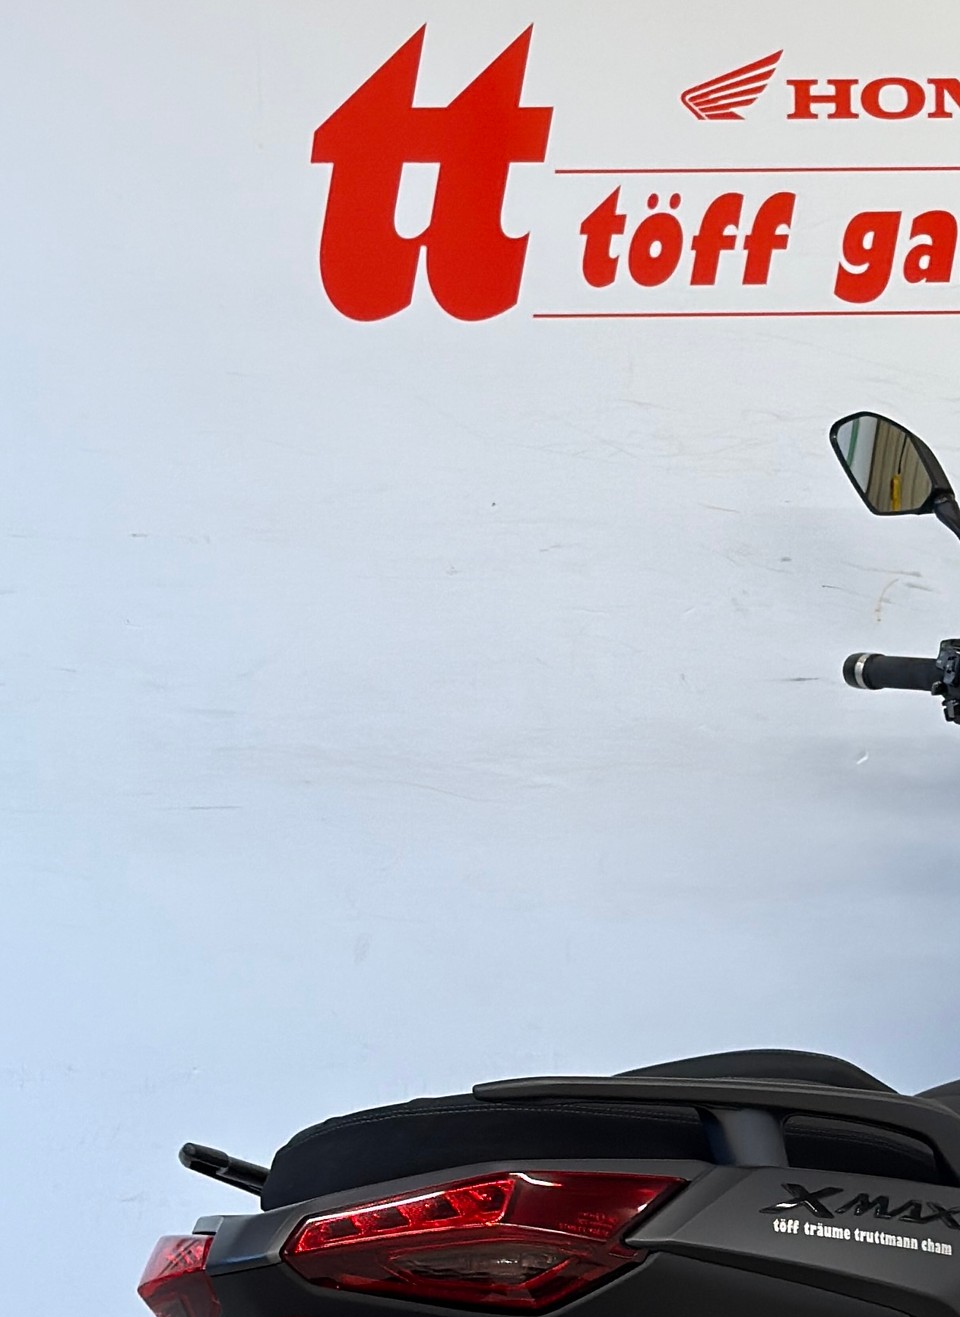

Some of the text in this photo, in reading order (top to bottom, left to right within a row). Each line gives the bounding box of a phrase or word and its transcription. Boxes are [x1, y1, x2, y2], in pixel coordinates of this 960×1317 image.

[580, 185, 796, 288] töff
[772, 1218, 953, 1255] töff träume truttmann cham
